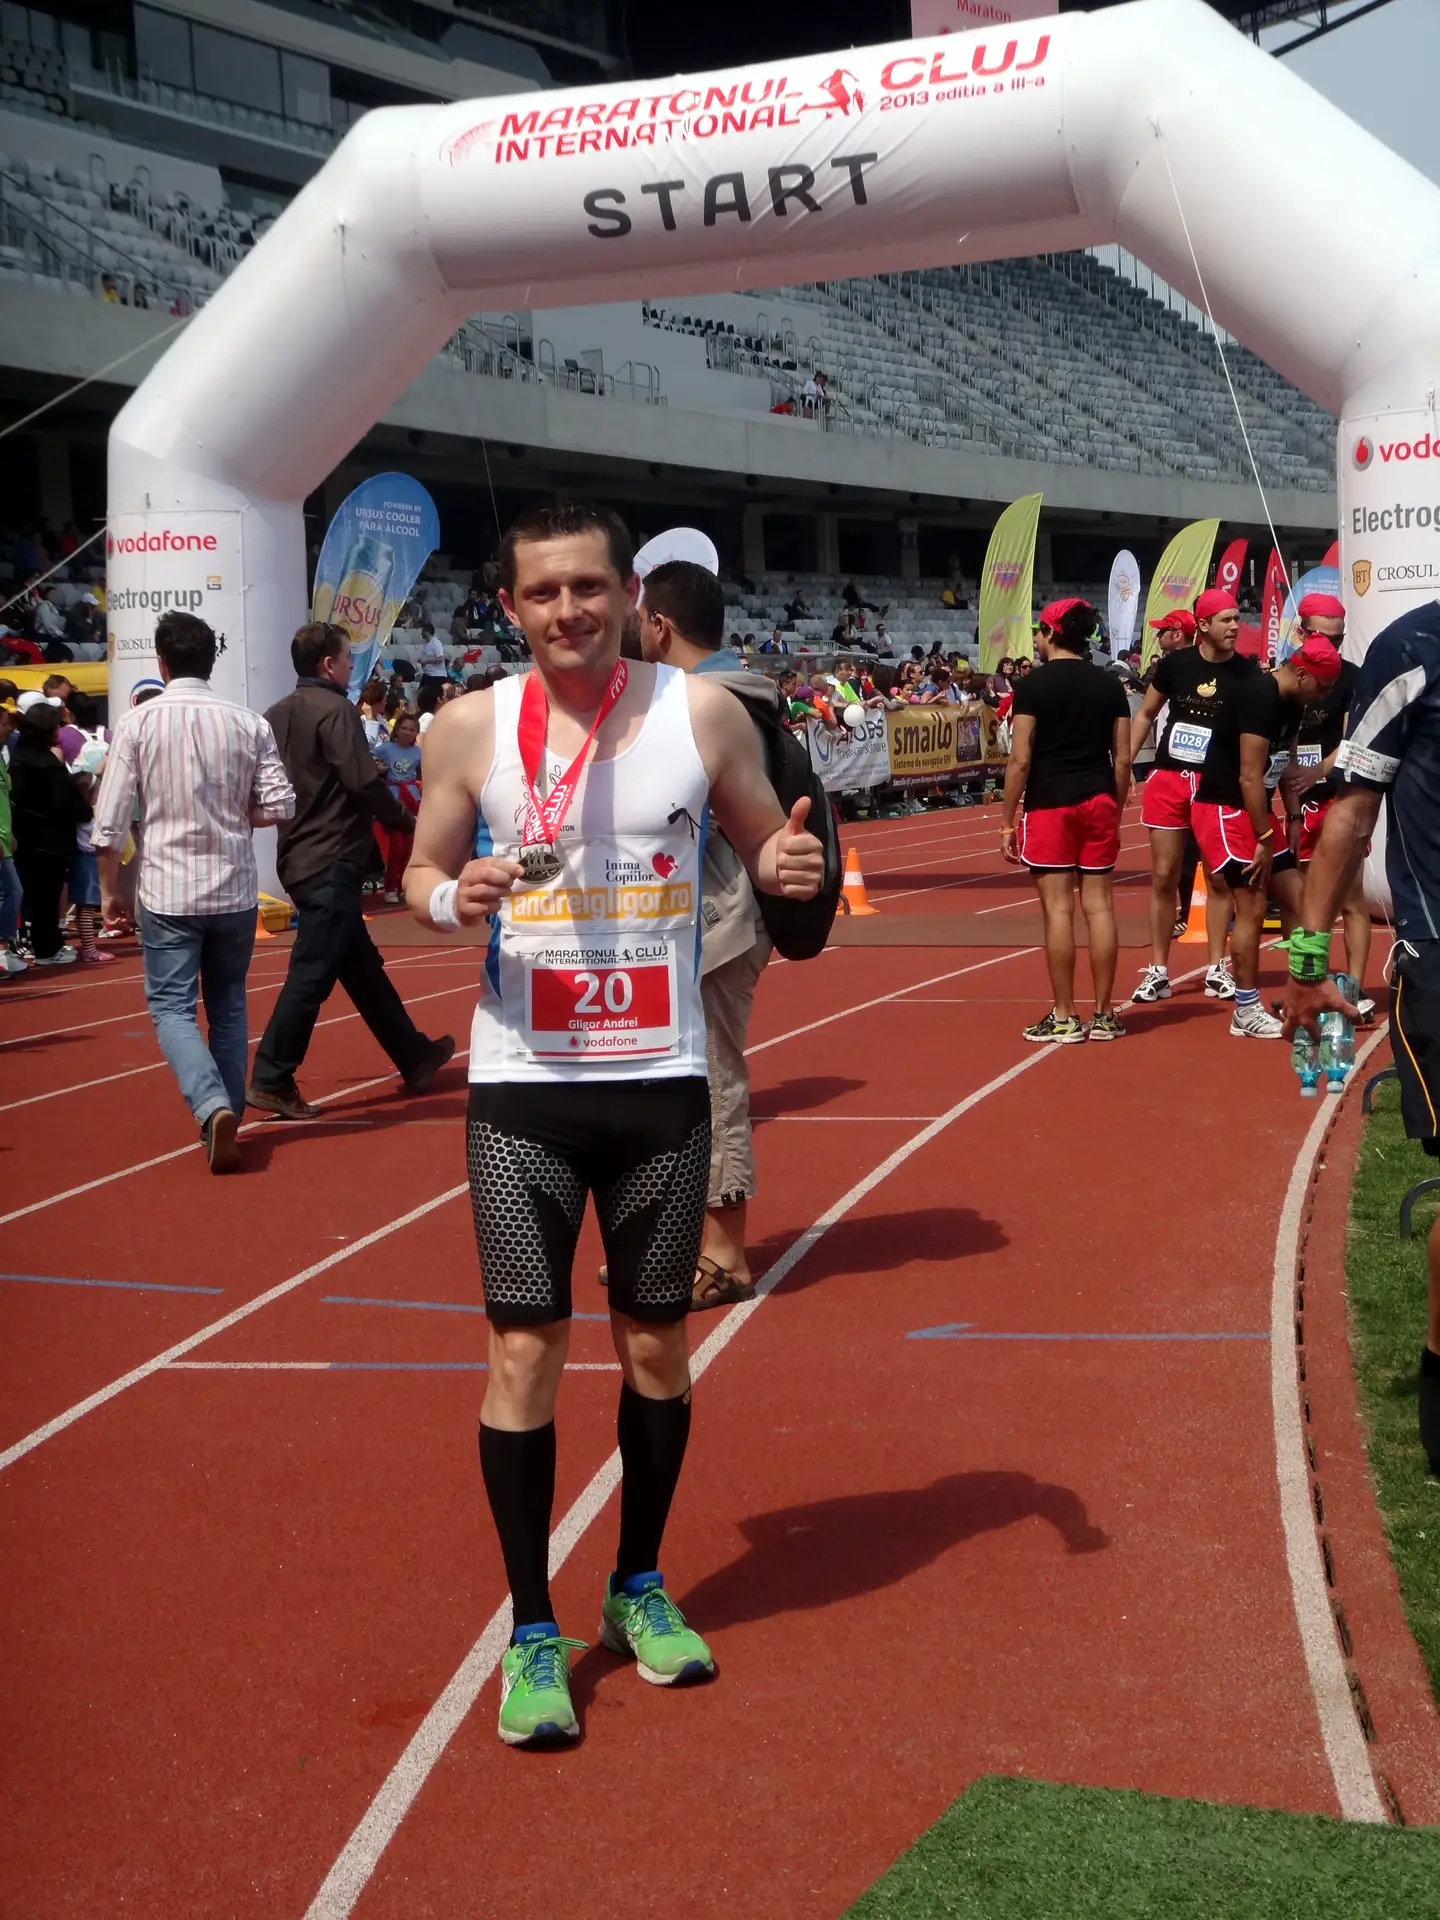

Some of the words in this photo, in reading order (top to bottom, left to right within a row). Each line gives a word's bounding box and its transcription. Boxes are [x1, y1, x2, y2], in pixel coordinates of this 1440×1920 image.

[880, 34, 1052, 91] CLUJ
[879, 91, 929, 112] 2013
[935, 83, 987, 102] editia
[993, 82, 1004, 94] a
[1011, 76, 1045, 91] III-a
[499, 76, 803, 137] MARATONUL
[494, 103, 800, 164] INTERNATIONAL
[583, 152, 878, 238] START
[355, 507, 383, 519] URSUS
[386, 511, 421, 525] COOLER
[117, 530, 218, 554] vodafone
[1355, 568, 1367, 584] BT
[1377, 563, 1439, 581] CROSUL
[893, 711, 953, 756] smailo
[605, 859, 640, 870] Inima
[605, 870, 654, 885] Copiilor
[514, 887, 690, 919] andreigligor.ro
[545, 949, 619, 958] MARATONUL
[635, 945, 668, 958] CLUJ
[545, 957, 620, 965] INTERNATIONAL
[574, 971, 633, 1014] 20
[568, 1018, 600, 1031] Gligor
[603, 1017, 638, 1029] Andrei
[583, 1035, 638, 1048] vodafone
